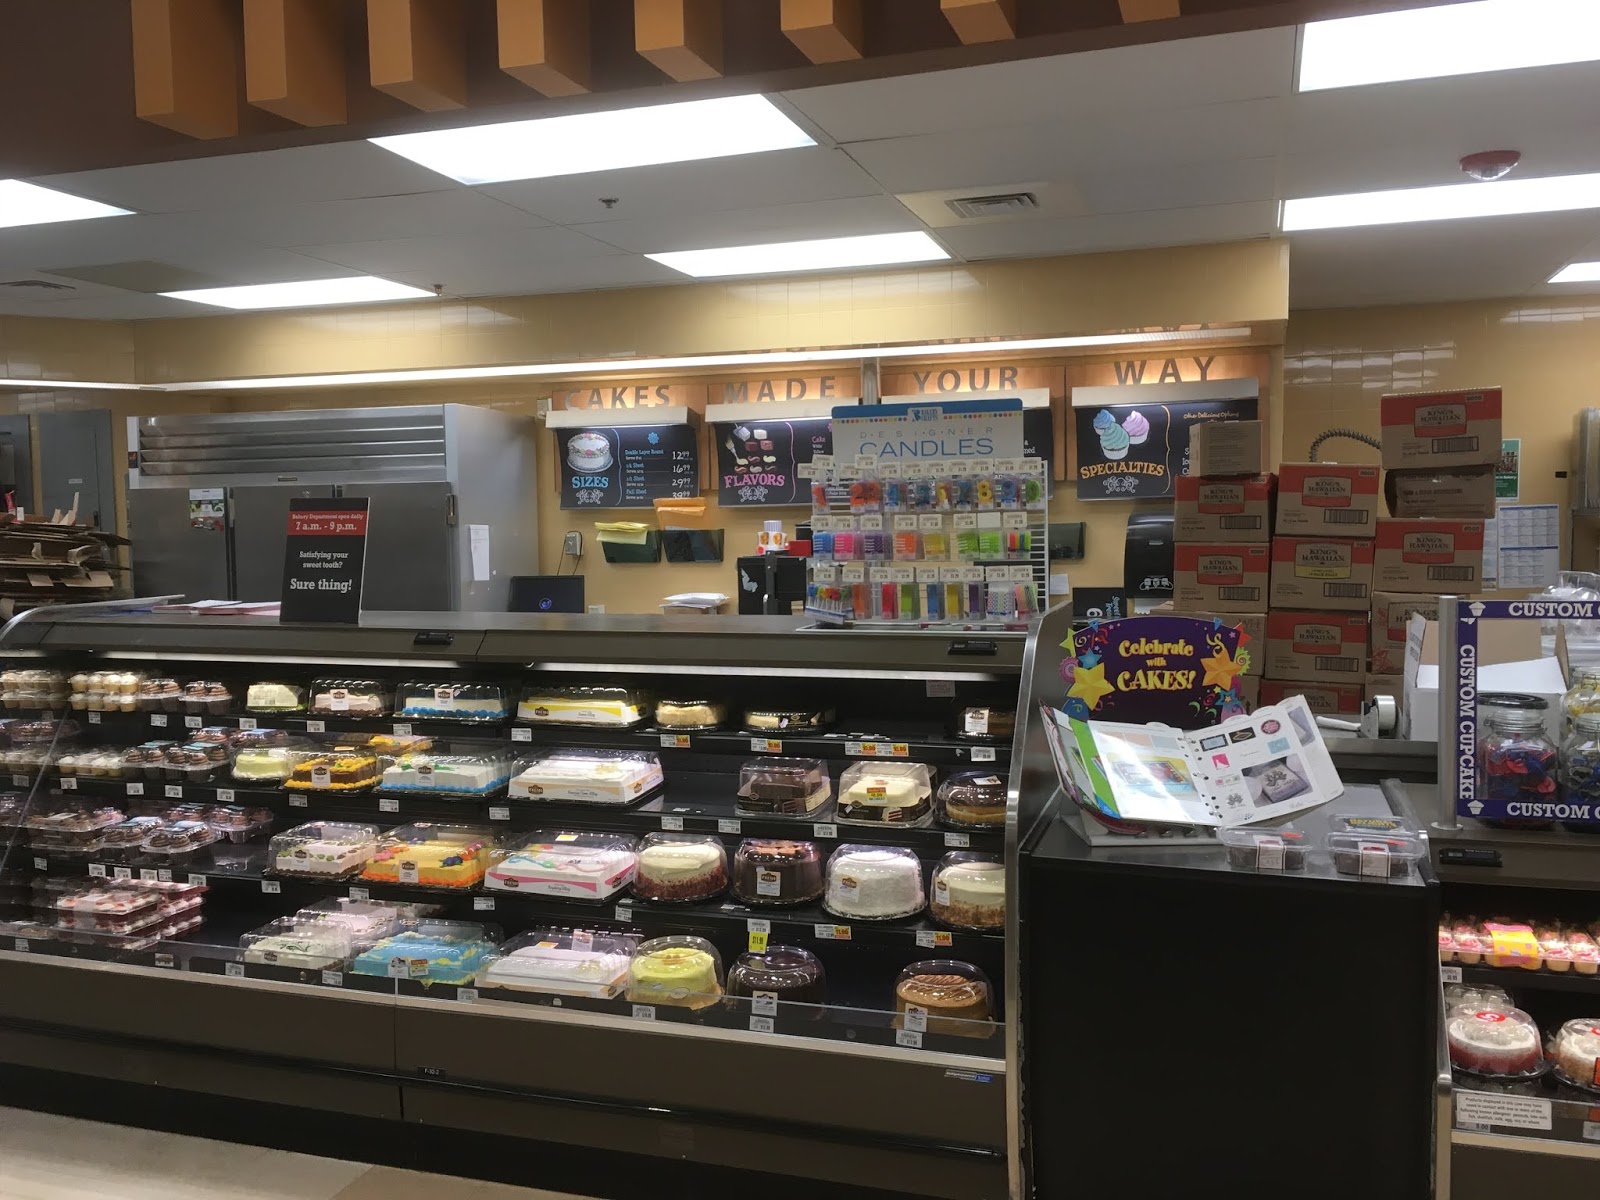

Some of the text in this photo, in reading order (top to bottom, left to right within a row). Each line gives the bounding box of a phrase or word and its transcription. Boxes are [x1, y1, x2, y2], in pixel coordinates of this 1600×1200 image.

[565, 355, 1216, 411] CAKES MADE YOUR WAY
[860, 438, 994, 458] CANDLES
[1080, 460, 1165, 480] SPECIALTIES
[572, 476, 609, 488] SIZES
[724, 473, 786, 488] FLAVORS
[296, 522, 301, 530] 7
[330, 522, 335, 530] 9
[336, 524, 357, 532] p.m.
[300, 551, 331, 560] Satisfying
[290, 578, 352, 593] Sure thing!
[1508, 602, 1593, 617] CUSTOM
[1119, 638, 1194, 657] Celebrate
[1146, 658, 1167, 667] with
[1116, 670, 1197, 691] CAKES!
[1459, 644, 1475, 800] CUSTOM CUPCAKE
[1507, 802, 1591, 819] CUSTOM
